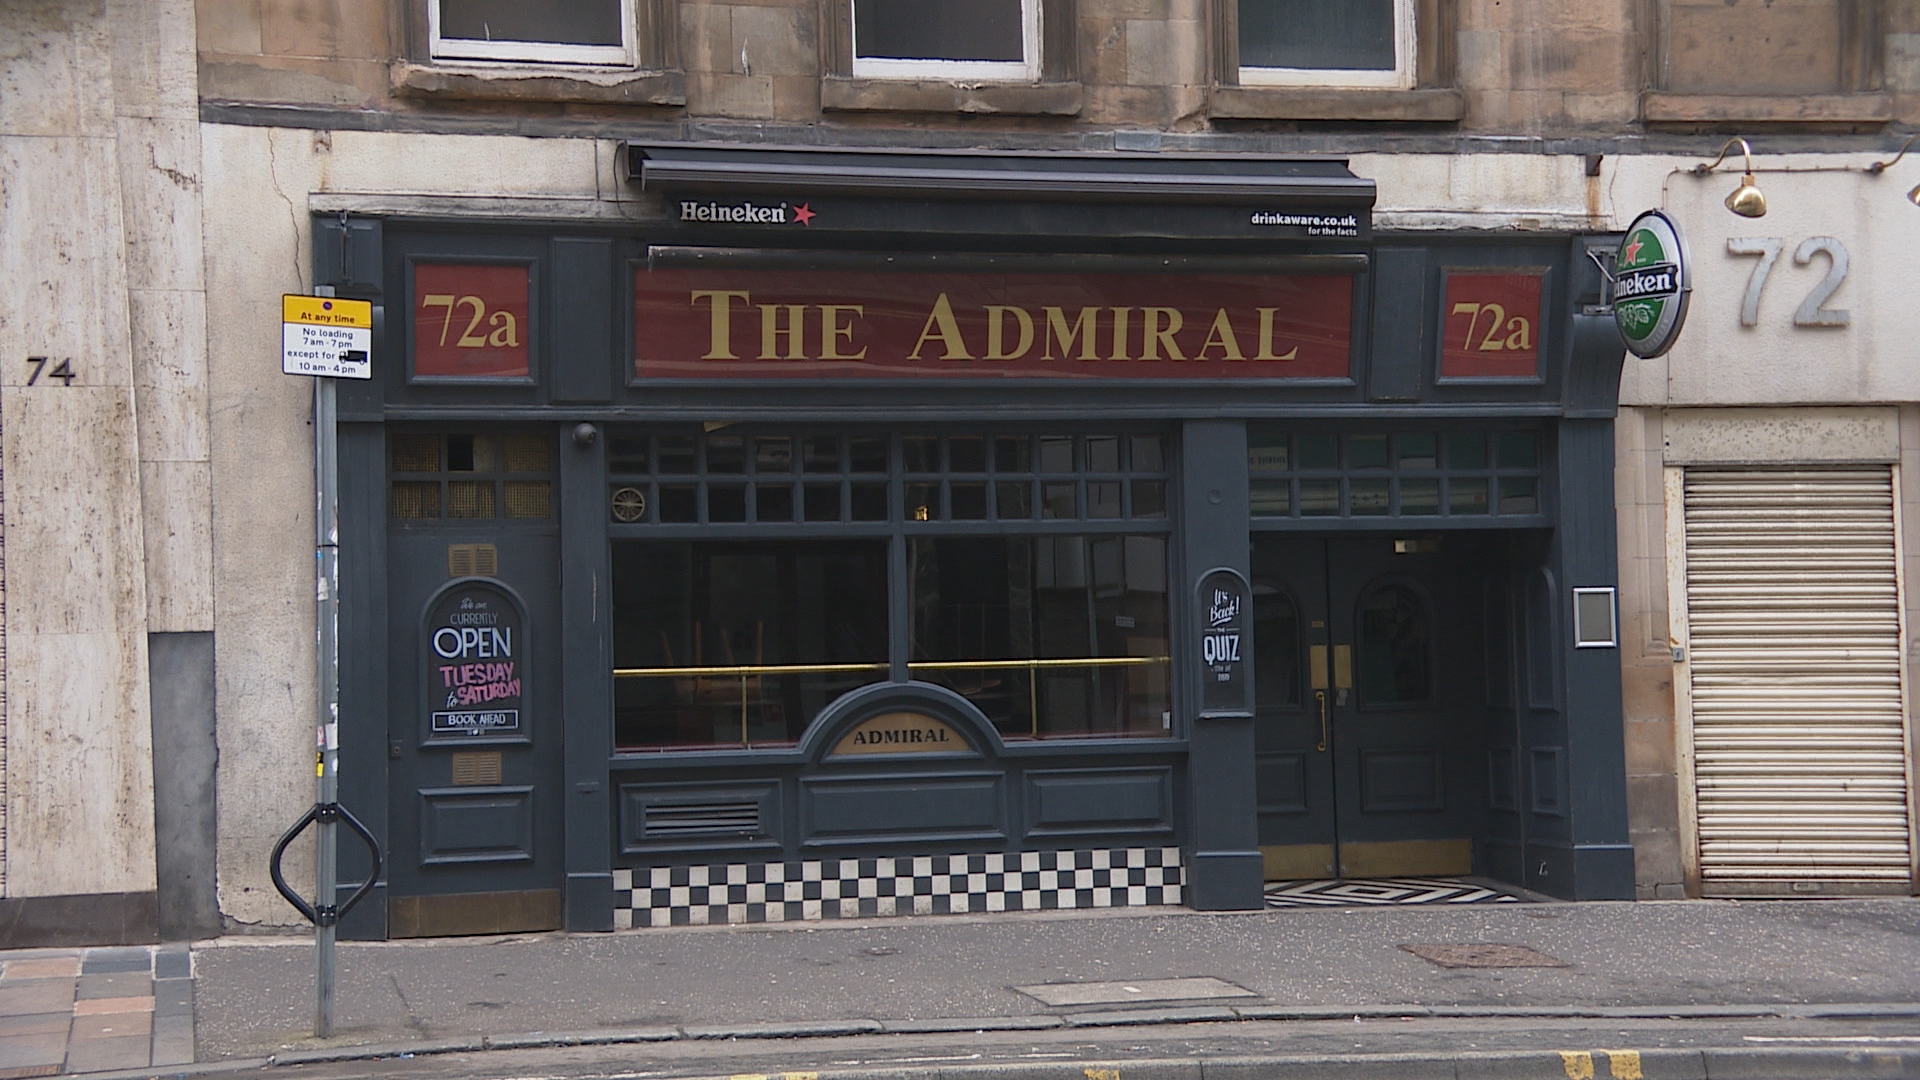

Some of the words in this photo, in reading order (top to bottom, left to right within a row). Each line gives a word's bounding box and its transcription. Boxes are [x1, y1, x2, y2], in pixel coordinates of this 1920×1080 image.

[680, 201, 787, 223] Heineken
[1251, 212, 1357, 227] drinkaware.co.uk
[1308, 227, 1321, 236] for
[1322, 227, 1335, 236] the
[1337, 227, 1357, 236] facts
[1726, 236, 1850, 328] 72
[301, 312, 312, 320] At
[315, 313, 331, 323] any
[335, 315, 355, 323] time
[422, 294, 519, 348] 72a
[691, 289, 868, 361] THE
[906, 292, 1298, 361] ADMIRAL
[1452, 303, 1531, 351] 72a
[303, 328, 316, 336] No
[319, 328, 354, 340] loading
[287, 350, 319, 359] except
[322, 351, 335, 360] for
[26, 356, 76, 387] 74
[450, 612, 499, 625] CURRENTLY
[433, 626, 512, 658] OPEN
[1203, 634, 1240, 665] QUIZ
[439, 661, 514, 688] TUESDAY
[457, 678, 521, 706] SATURDAY
[448, 713, 476, 726] BOOK
[479, 713, 506, 725] AHEAD
[854, 728, 949, 745] ADMIRAL
